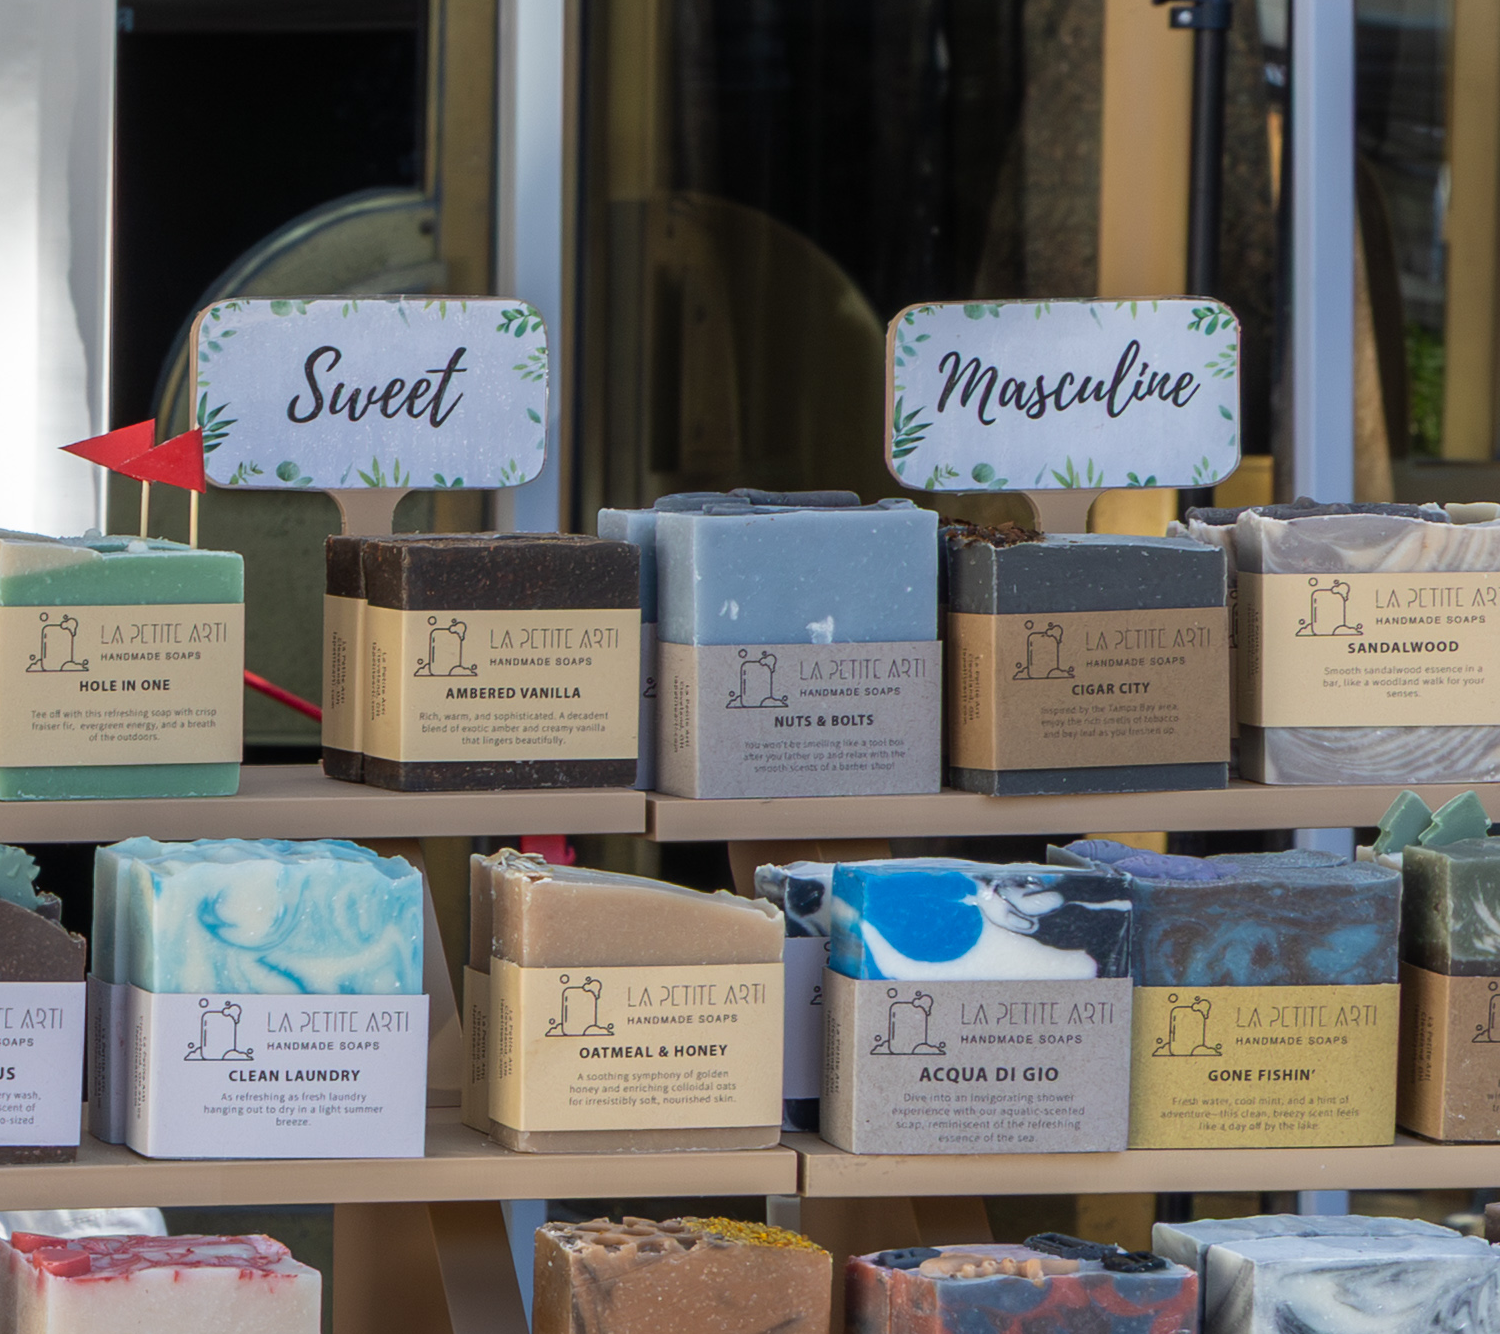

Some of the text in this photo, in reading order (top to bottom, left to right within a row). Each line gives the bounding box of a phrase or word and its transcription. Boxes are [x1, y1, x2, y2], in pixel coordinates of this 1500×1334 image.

[286, 345, 468, 429] Sweet
[937, 339, 1201, 426] Masculine
[1347, 640, 1459, 654] SANDALWOOD
[79, 679, 170, 692] HOLE IN ONE
[1071, 681, 1151, 696] CIGAR CITY
[445, 687, 581, 700] AMBERED VANILLA
[774, 713, 874, 728] NUTS & BOLTS
[627, 1013, 738, 1025] HANDMADE SOAPS
[579, 1044, 728, 1059] OATMEAL & HONEY
[228, 1069, 361, 1082] CLEAN LAUNDRY
[919, 1066, 1059, 1084] ACQUA DI GIO
[1207, 1069, 1253, 1082] GONE
